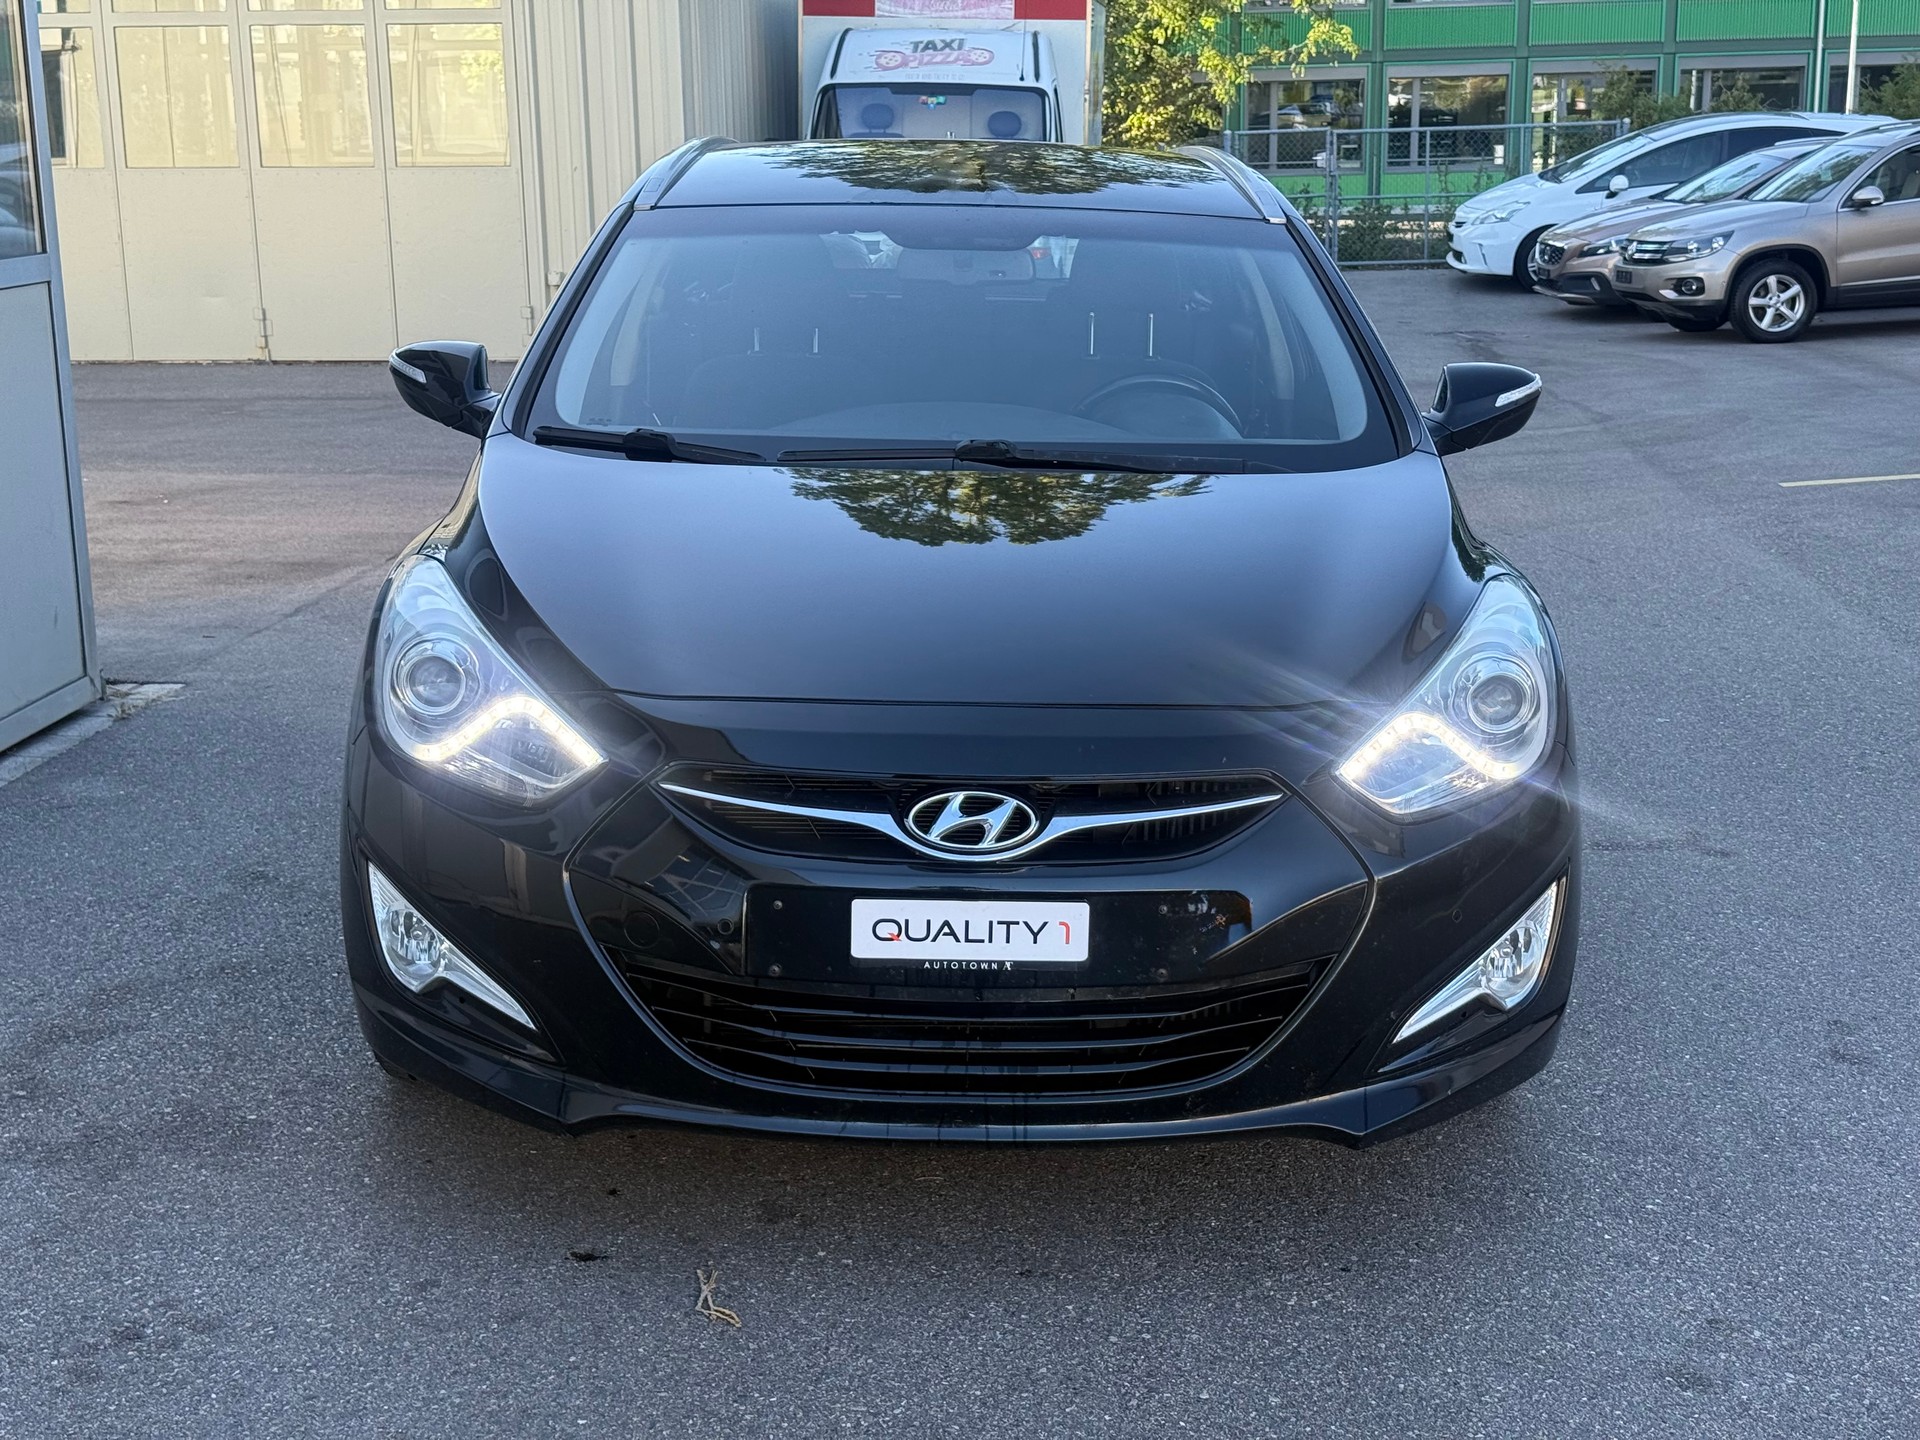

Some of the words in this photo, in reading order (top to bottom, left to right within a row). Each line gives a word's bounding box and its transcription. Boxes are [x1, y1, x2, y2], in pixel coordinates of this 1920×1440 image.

[910, 38, 966, 53] TAXI
[906, 52, 972, 68] PIZZA
[872, 918, 1049, 945] QUALITY
[1058, 921, 1071, 945] 1
[923, 961, 998, 970] AUTOTOWN
